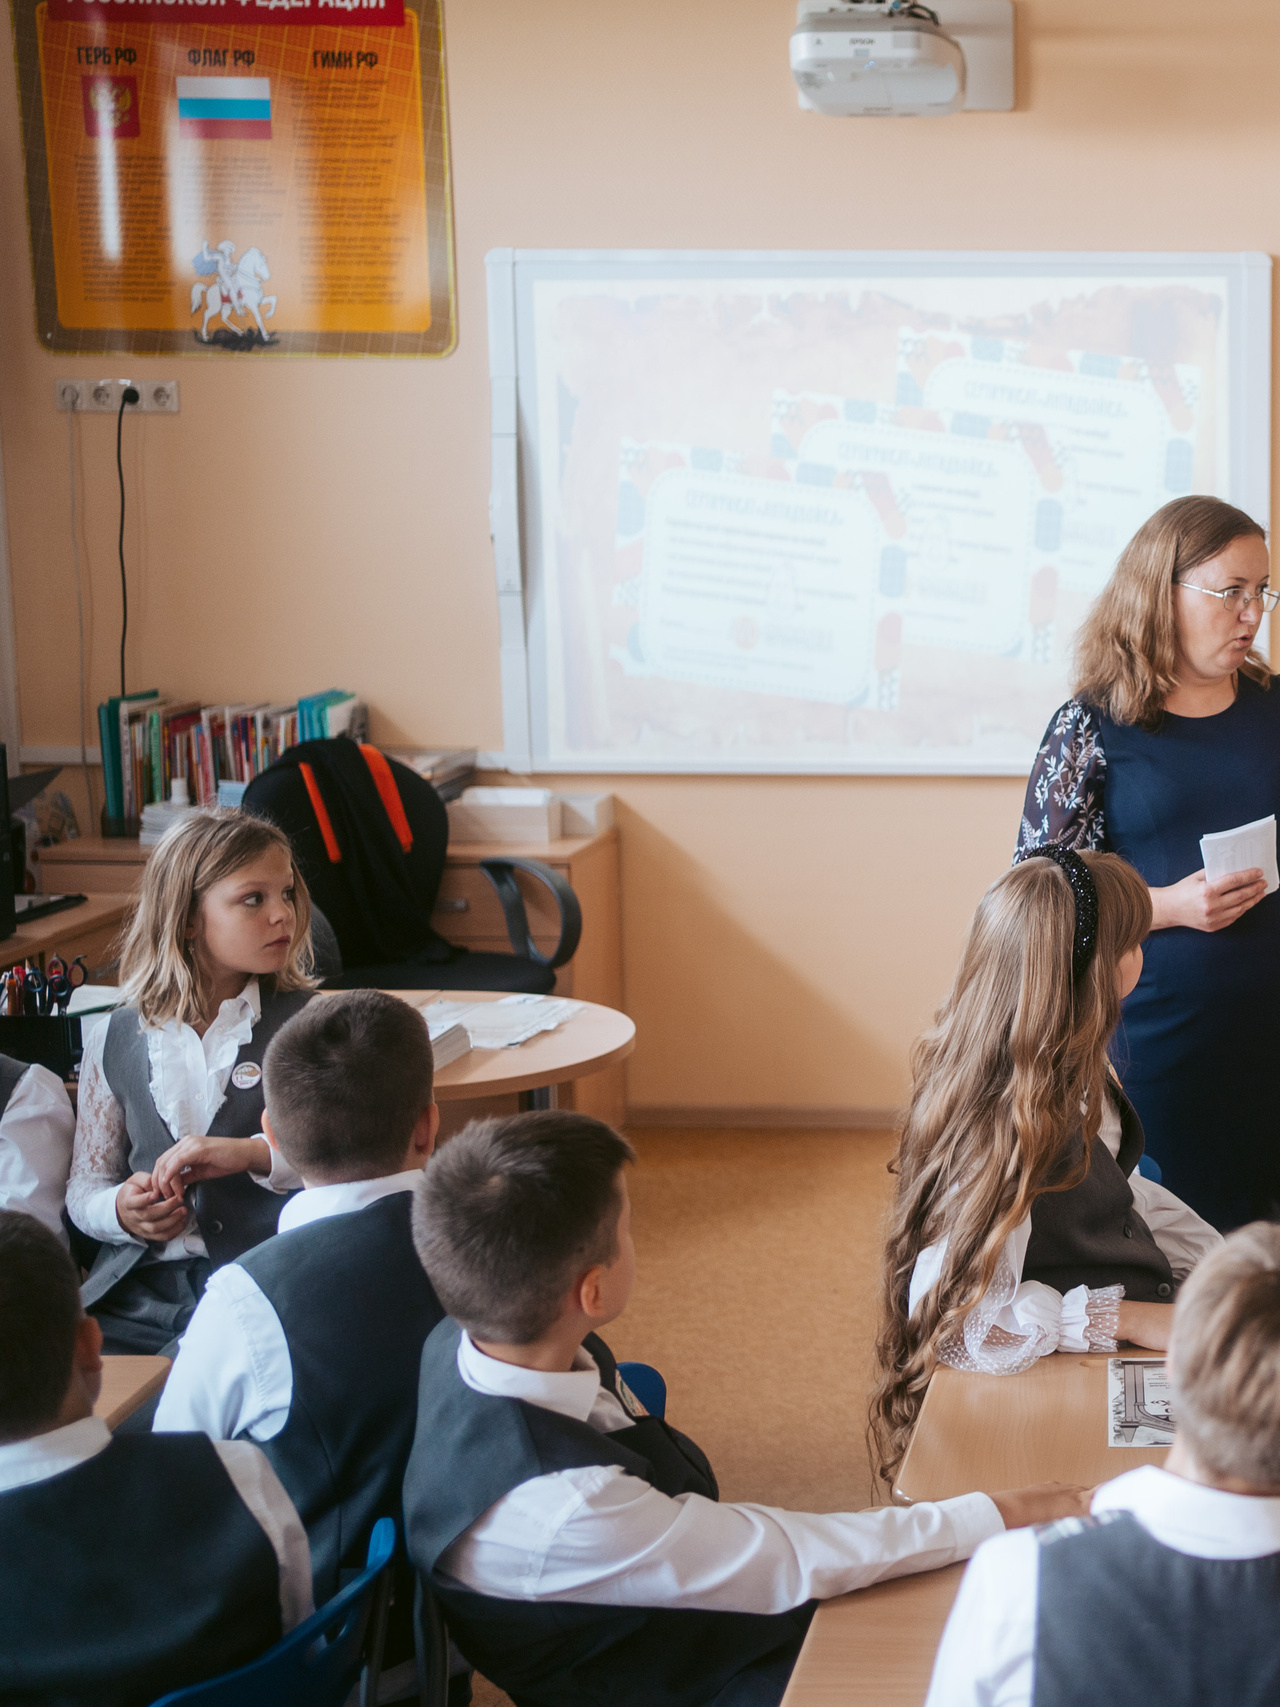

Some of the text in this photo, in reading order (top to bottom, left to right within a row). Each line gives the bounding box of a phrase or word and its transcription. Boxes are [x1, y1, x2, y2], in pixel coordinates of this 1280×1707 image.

[77, 46, 137, 66] ГЕРБ РФ
[187, 48, 255, 67] ФЛАГ РФ
[313, 50, 378, 69] ГИМН РФ
